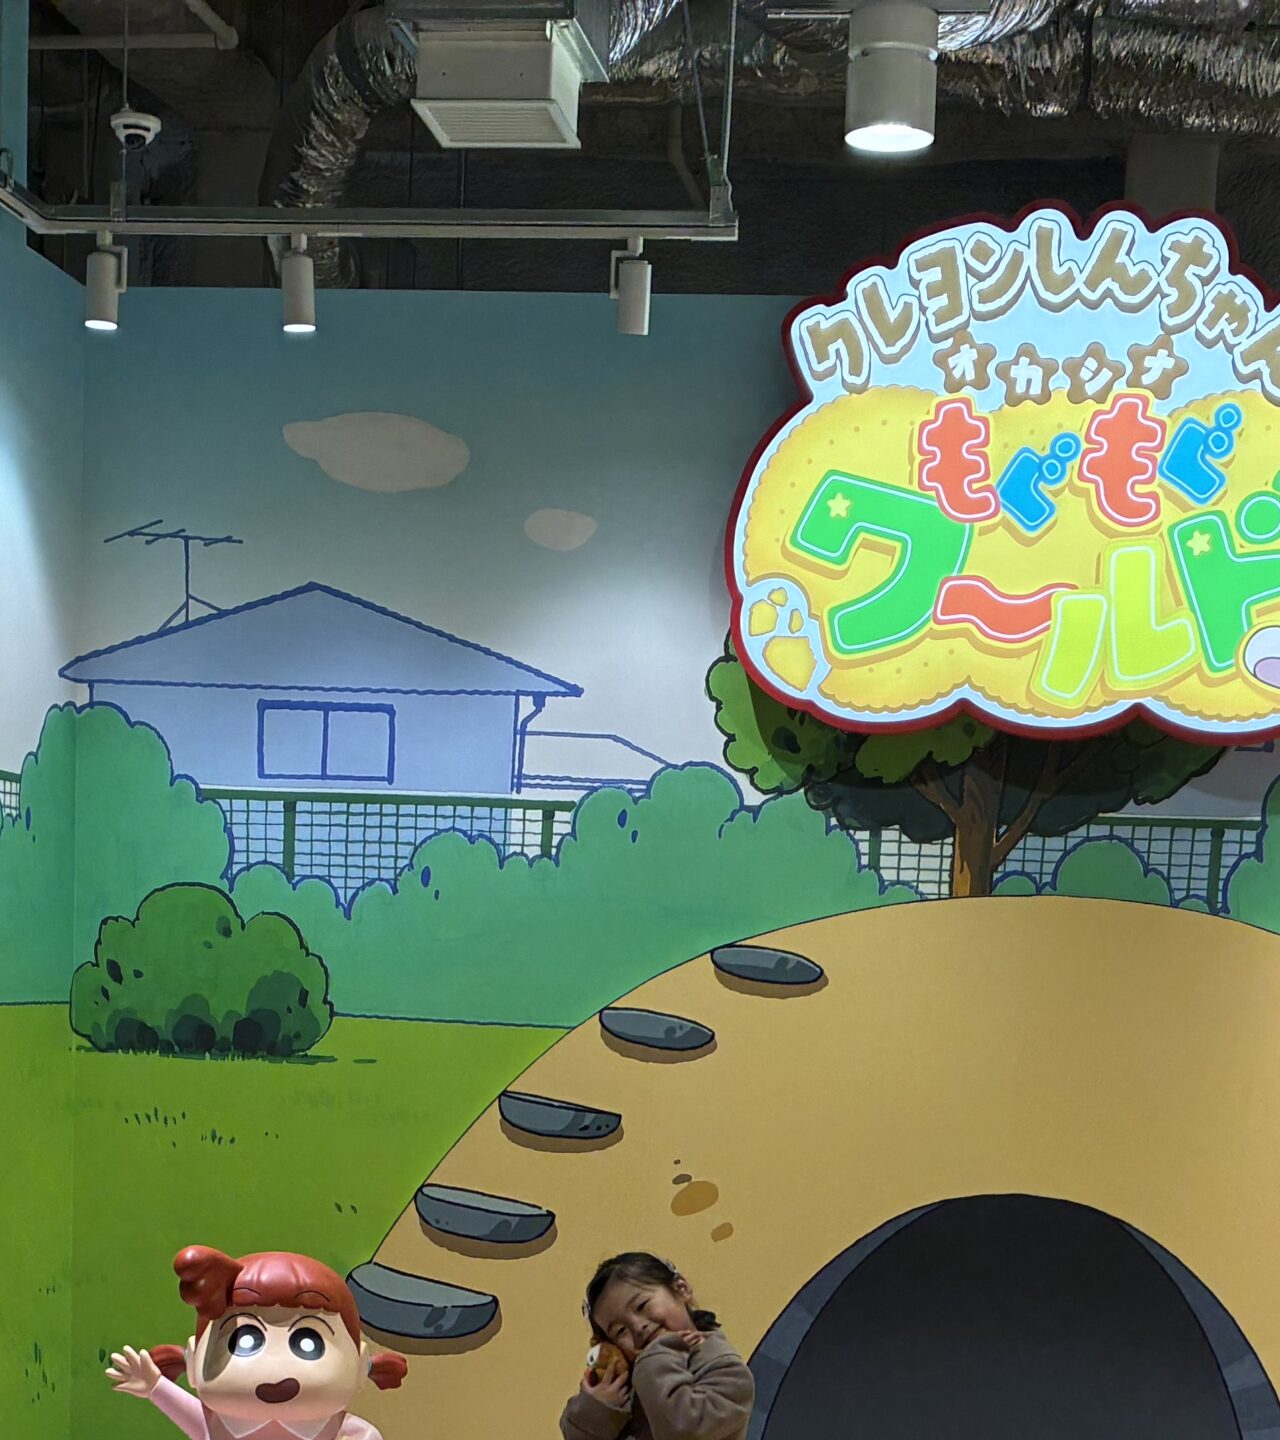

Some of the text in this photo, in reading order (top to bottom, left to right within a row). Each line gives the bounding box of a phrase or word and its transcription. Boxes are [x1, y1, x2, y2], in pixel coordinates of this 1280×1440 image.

[947, 342, 1176, 396] オカシナ
[918, 394, 1242, 532] もぐもぐ
